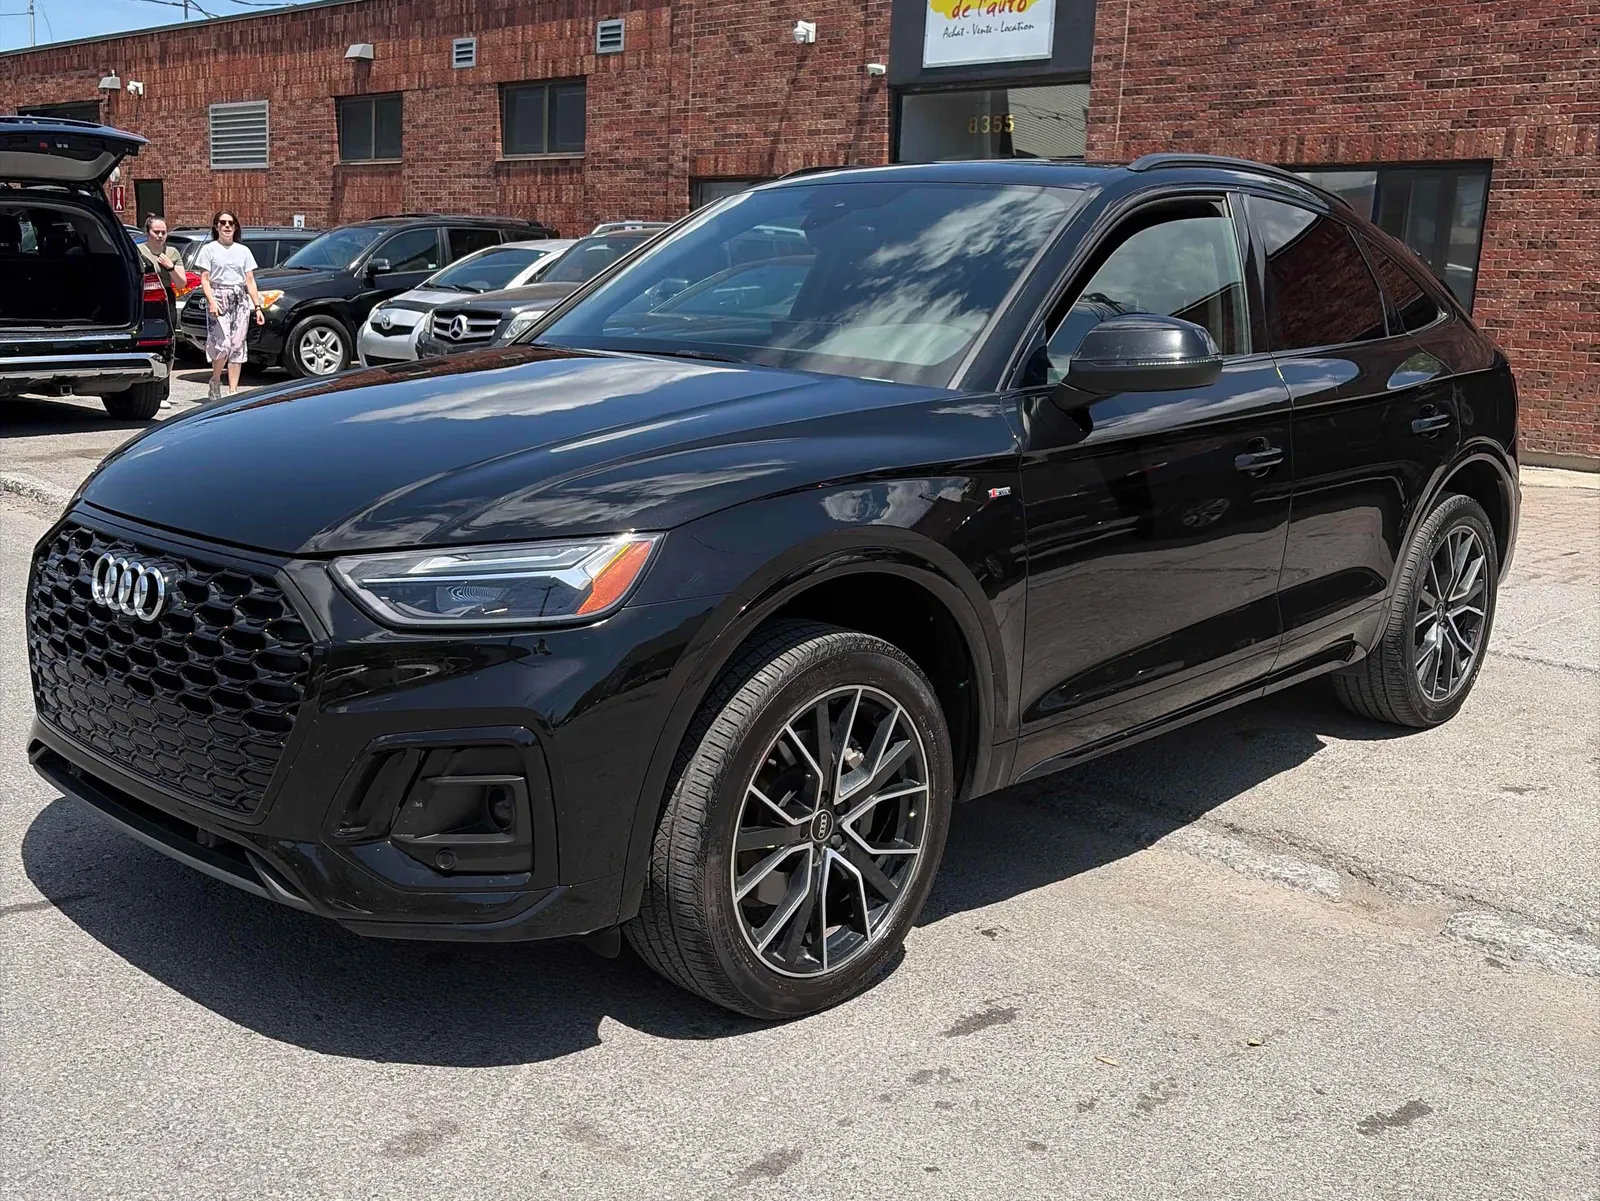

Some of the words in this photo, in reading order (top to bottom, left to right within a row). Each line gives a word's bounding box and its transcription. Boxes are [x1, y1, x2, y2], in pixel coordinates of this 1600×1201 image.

[951, 0, 971, 20] de
[977, 0, 1028, 18] l'auto
[942, 25, 965, 39] Achat
[972, 23, 993, 35] Vente
[1000, 21, 1035, 33] Location
[968, 115, 1015, 134] 8355
